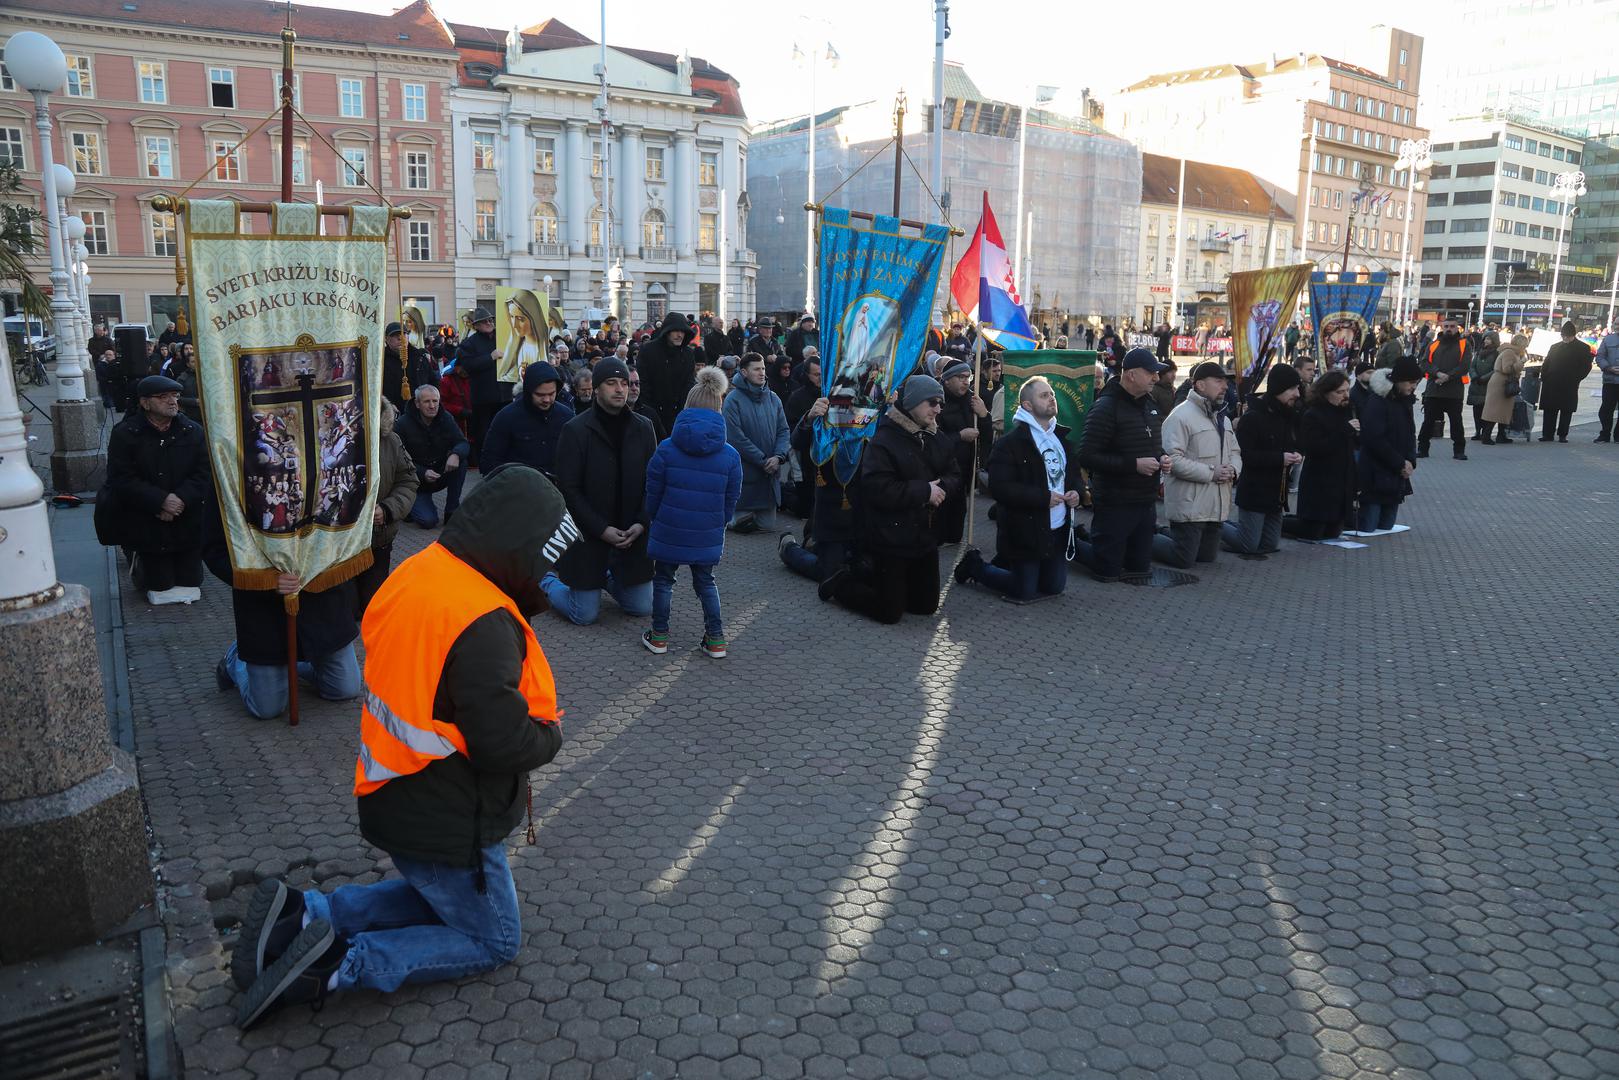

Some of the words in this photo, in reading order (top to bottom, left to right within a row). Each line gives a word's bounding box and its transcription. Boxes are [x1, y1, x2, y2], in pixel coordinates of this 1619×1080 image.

[206, 272, 260, 304] SVETI
[263, 262, 318, 283] KRIŽU
[325, 267, 380, 300] ISUSOV,
[211, 292, 296, 332] BARJAKU
[303, 290, 378, 324] KRŠĆANA
[1176, 338, 1193, 349] BEZ
